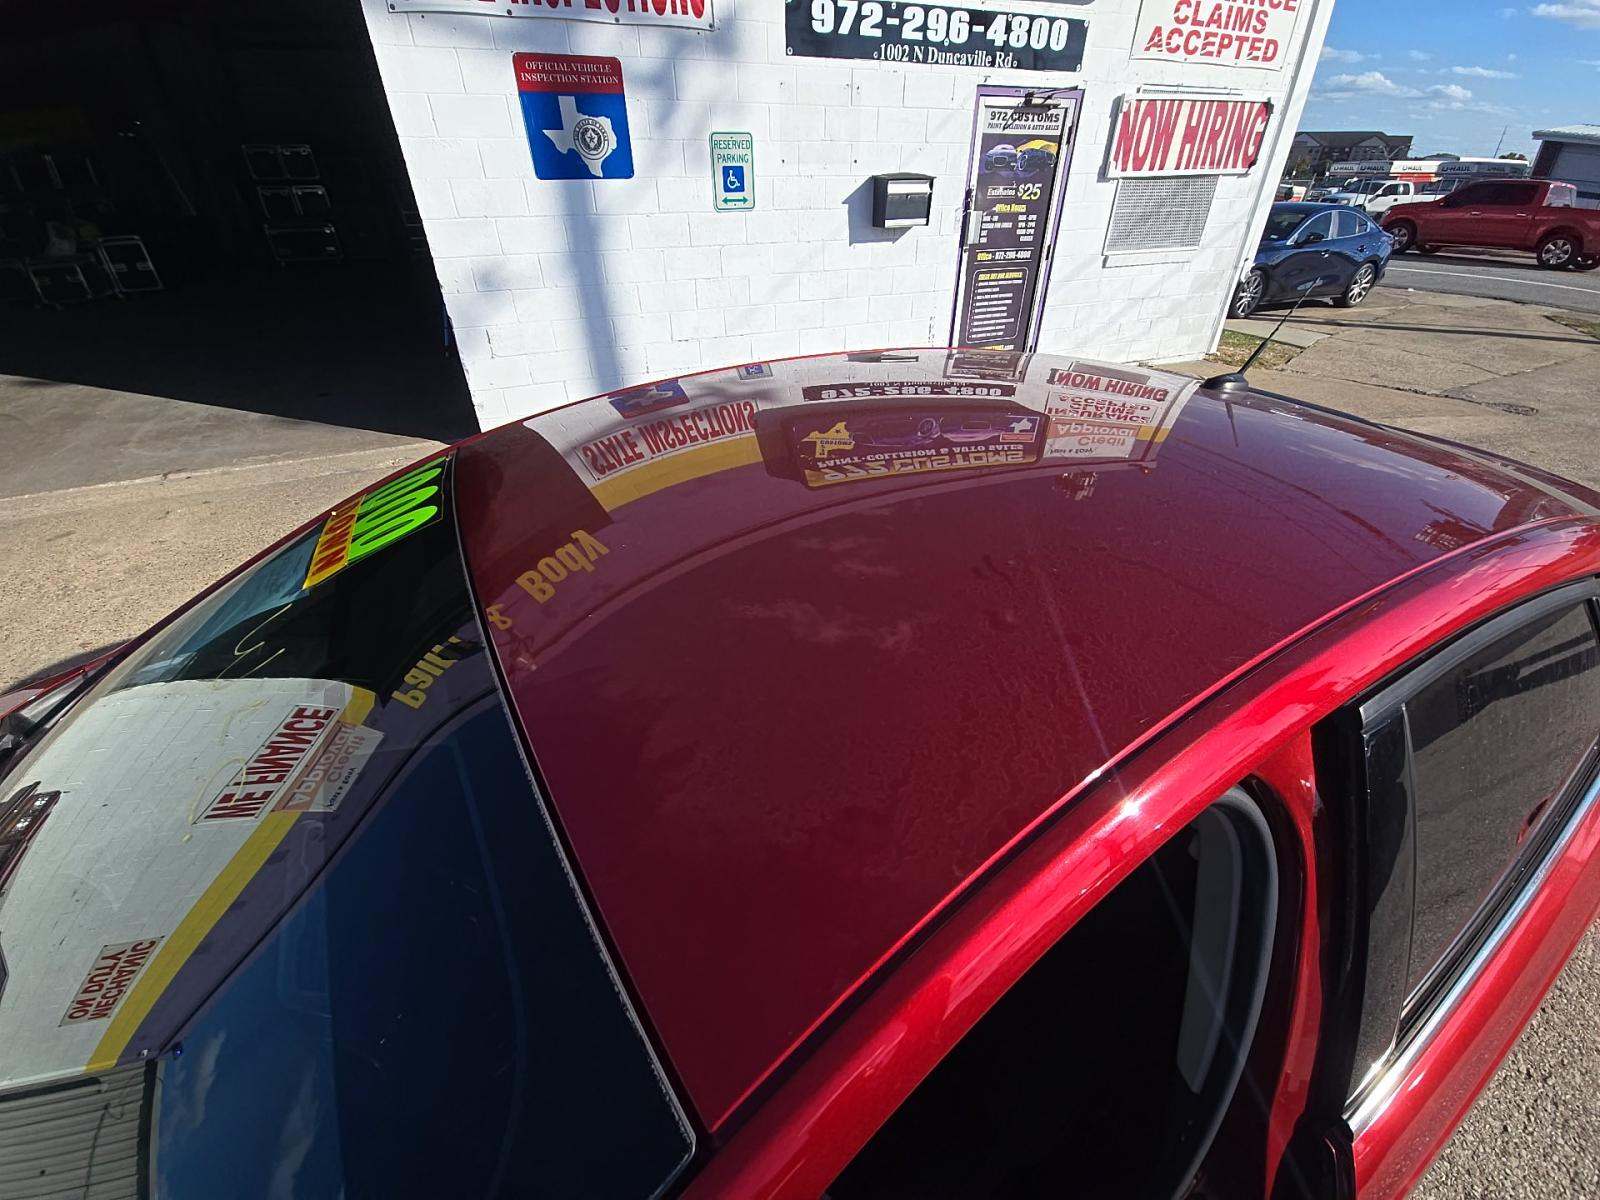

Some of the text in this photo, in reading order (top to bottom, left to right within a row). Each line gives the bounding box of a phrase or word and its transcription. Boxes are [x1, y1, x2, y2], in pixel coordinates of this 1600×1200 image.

[811, 0, 1069, 51] 972-296-4800
[1173, 0, 1269, 34] CLAIMS
[1143, 25, 1280, 63] ACCEPTED
[880, 43, 1013, 68] 1002 N Duncaville Rd
[525, 61, 612, 73] OFFICIAL VEHICLE
[520, 72, 619, 84] INSPECTION STATION
[990, 110, 1060, 123] 972 CUSTOMS
[713, 139, 751, 150] RESERVED
[1113, 100, 1270, 172] NOW HIRING
[717, 153, 749, 163] PARKING
[1017, 183, 1042, 200] $25
